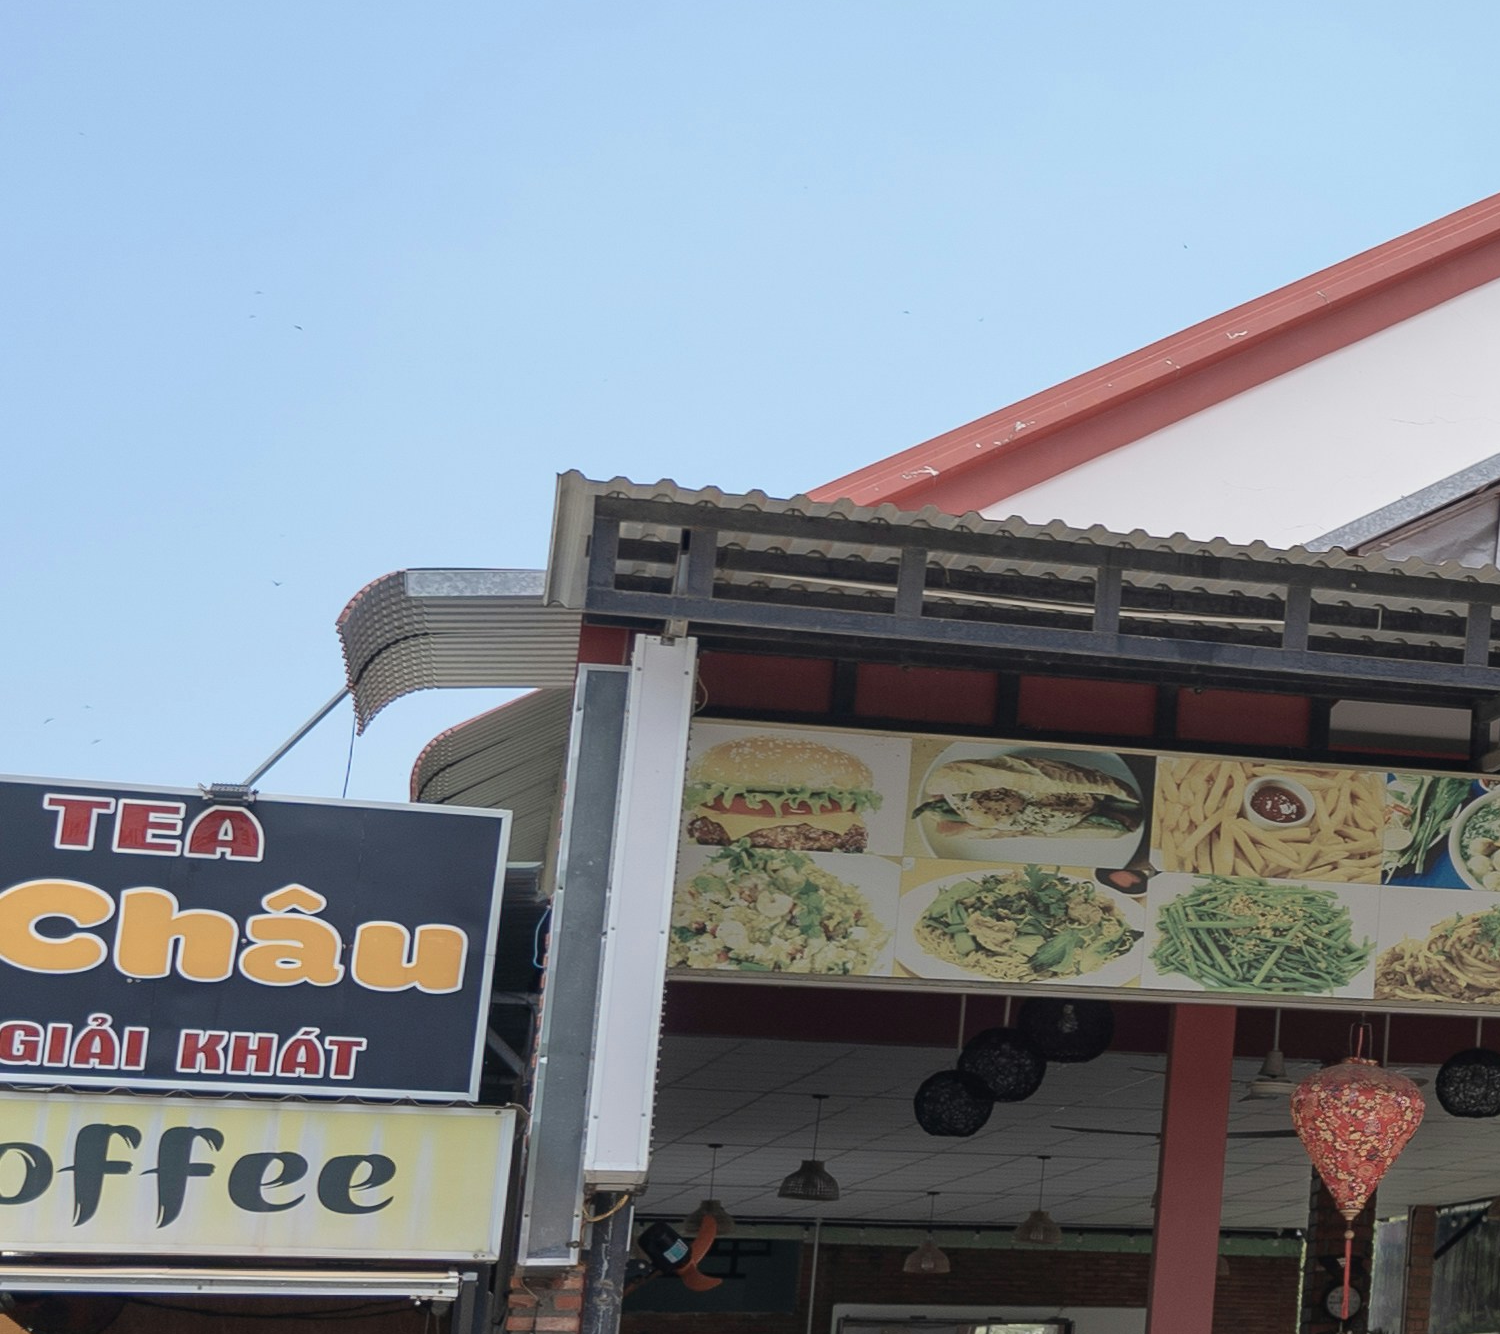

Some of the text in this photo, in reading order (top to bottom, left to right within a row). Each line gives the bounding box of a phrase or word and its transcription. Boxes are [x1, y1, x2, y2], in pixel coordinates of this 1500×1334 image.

[44, 793, 265, 862] TEA
[0, 878, 469, 995] Châu
[0, 1014, 367, 1080] GIẢI KHÁT
